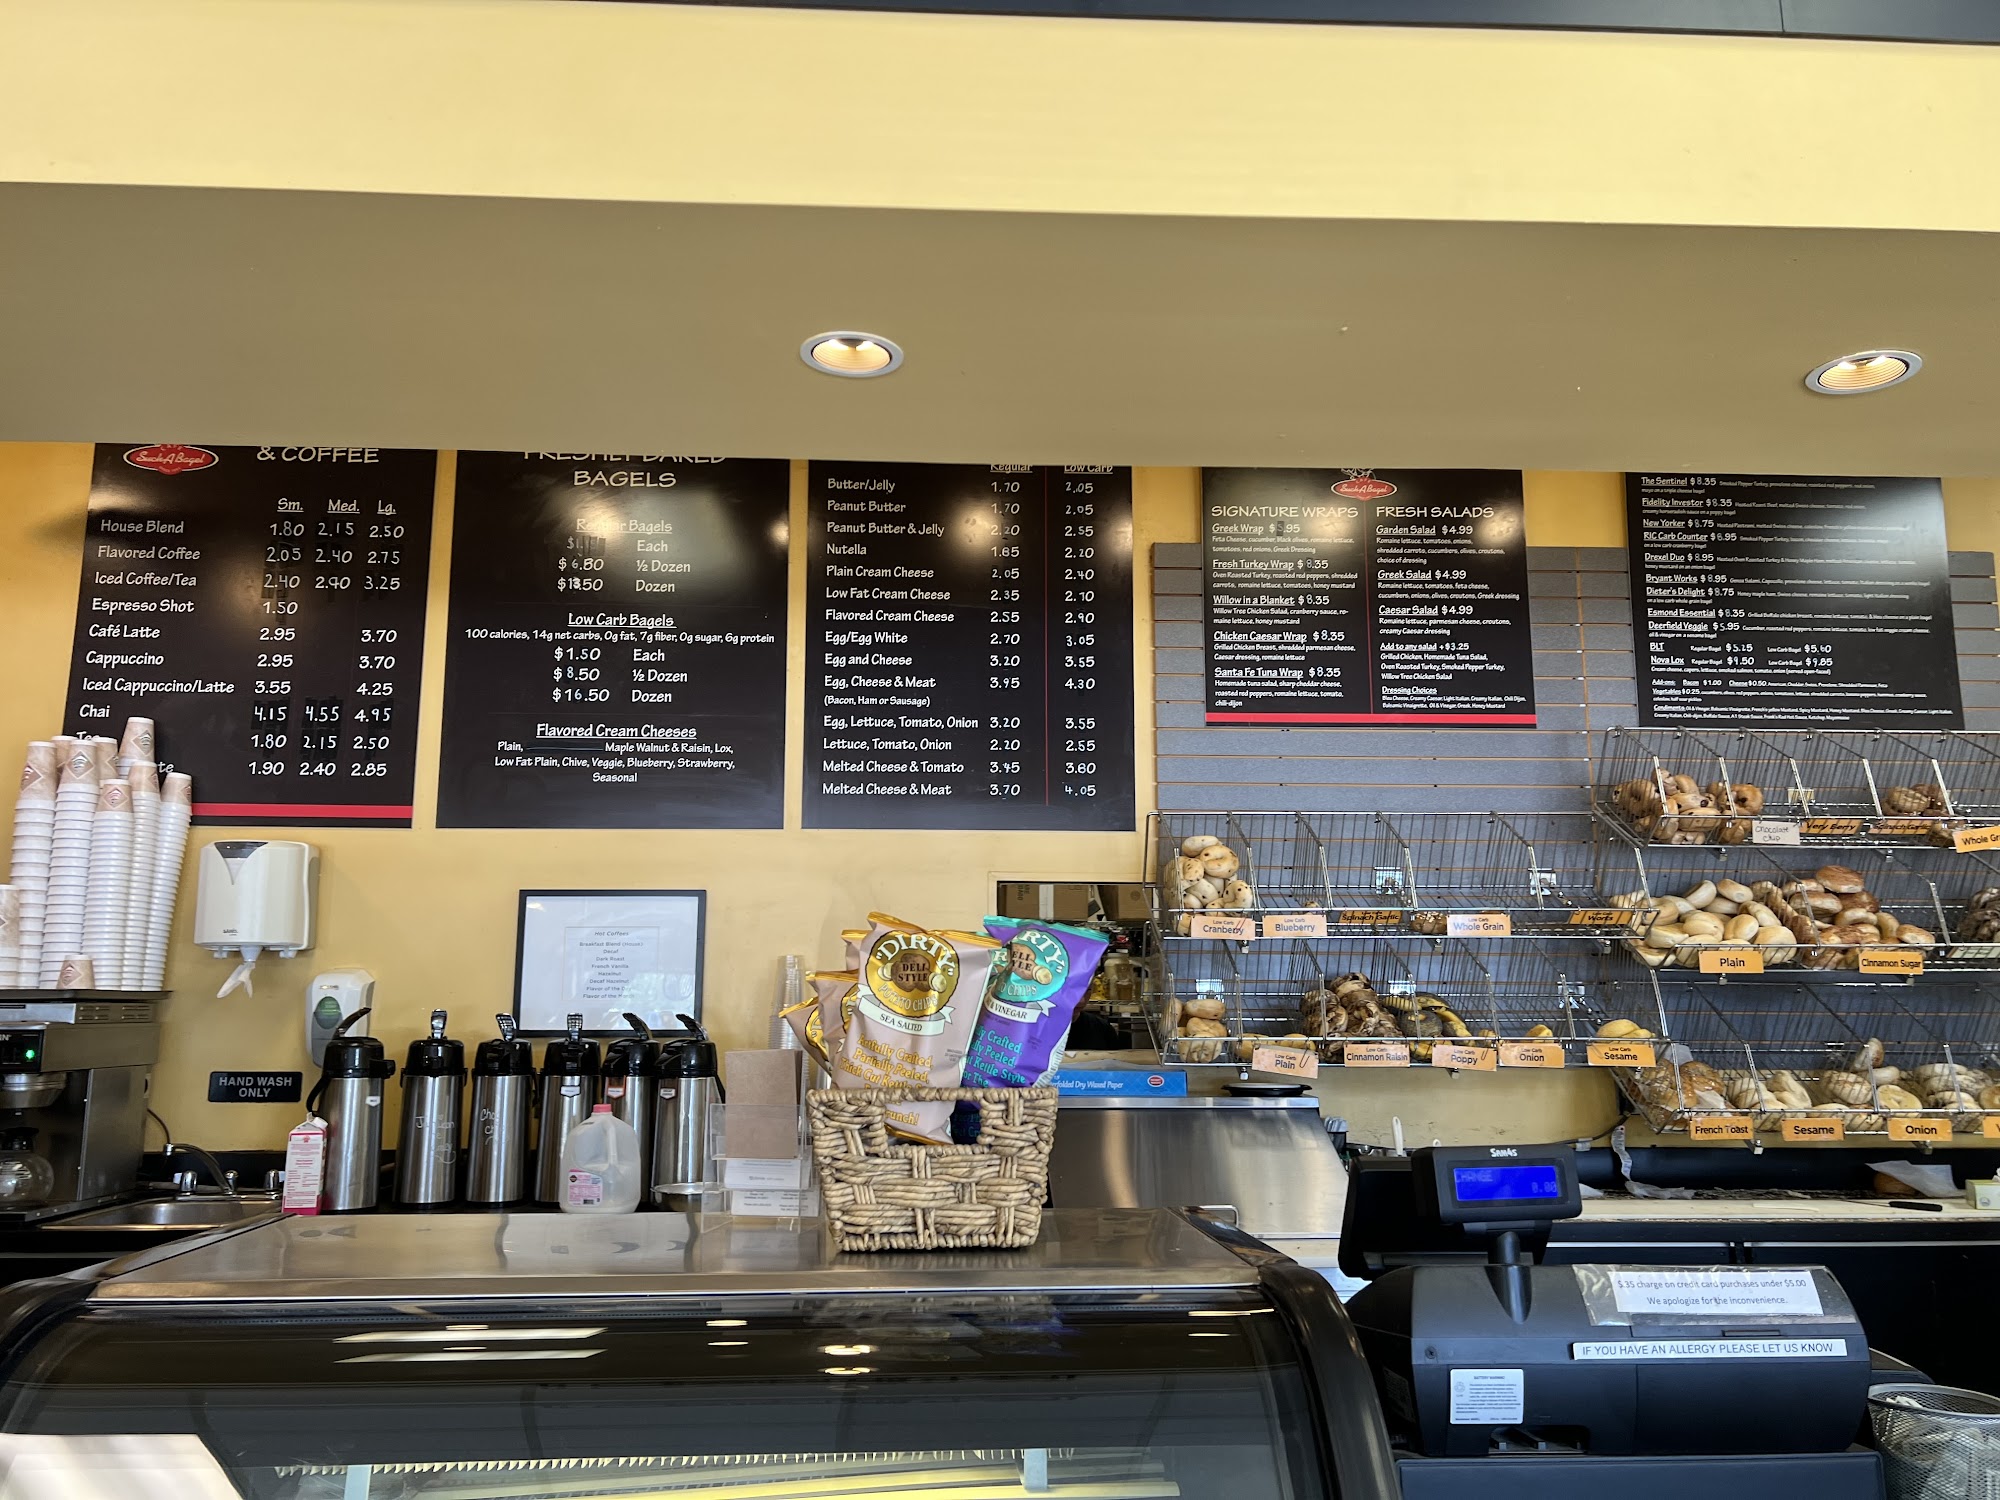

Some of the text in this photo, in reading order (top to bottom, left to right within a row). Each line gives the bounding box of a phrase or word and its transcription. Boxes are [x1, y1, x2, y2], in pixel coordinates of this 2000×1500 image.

[257, 446, 379, 463] & COFFEE
[574, 471, 677, 487] BAGELS
[1641, 477, 1687, 486] The Sentinel
[827, 478, 895, 493] Butter/Jelly
[991, 482, 1020, 493] 1.70
[278, 498, 396, 514] Sm. Med. Lg.
[1211, 505, 1359, 518] SIGNATURE WRAPS
[1376, 506, 1494, 518] FRESH SALADS
[100, 520, 404, 538] House Blend 1.80 2.15 2.50
[1376, 525, 1473, 535] Garden Salad $4.99
[98, 546, 400, 564] Flavored Coffee 2.05 2.40 2.75
[1377, 570, 1466, 580] Greek Salad $4.99
[92, 598, 298, 615] Espresso Shot 1.50
[569, 614, 674, 629] Low Carb Bagels
[465, 629, 488, 639] 100
[489, 629, 530, 641] calories,
[532, 630, 553, 642] 14g
[554, 632, 571, 640] net
[573, 630, 603, 642] carbs,
[619, 631, 637, 641] fat,
[640, 632, 653, 643] 7g
[655, 632, 678, 643] fiber,
[825, 632, 1095, 646] Egg/Egg White 2.70 3.05
[1214, 630, 1345, 643] Chicken Caesar Wrap $8.35
[1650, 642, 1665, 651] BLT
[86, 651, 395, 669] Cappuccino 2.95 3.70
[825, 654, 1095, 668] Egg and Cheese 3.20 3.55
[824, 696, 856, 706] (Bacon,
[858, 696, 877, 705] Ham
[890, 696, 930, 707] Sausage)
[79, 704, 392, 722] Chai 4.15 4.55 4.95
[536, 724, 696, 738] Flavored Cream Cheeses
[593, 773, 638, 782] Seasonal
[823, 784, 863, 795] Melted
[866, 784, 907, 795] Cheese
[909, 785, 919, 795] &
[921, 784, 952, 795] Meat
[989, 786, 1020, 797] 3.70
[1275, 923, 1315, 932] Blueberry
[1453, 922, 1505, 931] Whole Grain
[902, 963, 926, 971] DELI
[1720, 957, 1745, 969] Plain
[1861, 958, 1921, 971] Cinnamon Sugar
[898, 973, 928, 982] STYLE
[994, 1005, 1027, 1019] VINEGAR
[880, 1013, 923, 1032] SEA SALTED
[1346, 1053, 1384, 1061] Cinnamon
[1451, 1055, 1478, 1067] Poppy
[1519, 1053, 1545, 1063] Onion
[1604, 1052, 1638, 1062] Sesame
[1275, 1060, 1295, 1069] Plain
[219, 1077, 292, 1086] HAND WASH
[1075, 1081, 1085, 1089] Dry
[1108, 1081, 1124, 1089] Paper
[239, 1088, 271, 1098] ONLY
[1695, 1124, 1748, 1135] French Toast
[1794, 1125, 1835, 1135] Sesame
[1905, 1125, 1938, 1135] Onion
[1636, 1280, 1663, 1290] charge
[1677, 1280, 1700, 1288] credit
[1701, 1280, 1718, 1288] card
[1720, 1280, 1759, 1289] purchases
[1760, 1279, 1783, 1288] under
[1784, 1279, 1807, 1288] $5.00
[1647, 1296, 1788, 1307] We apologize for the inconvenience.
[1582, 1343, 1833, 1355] IF YOU HAVE AN ALLERGY PLEASE LET US KNOW
